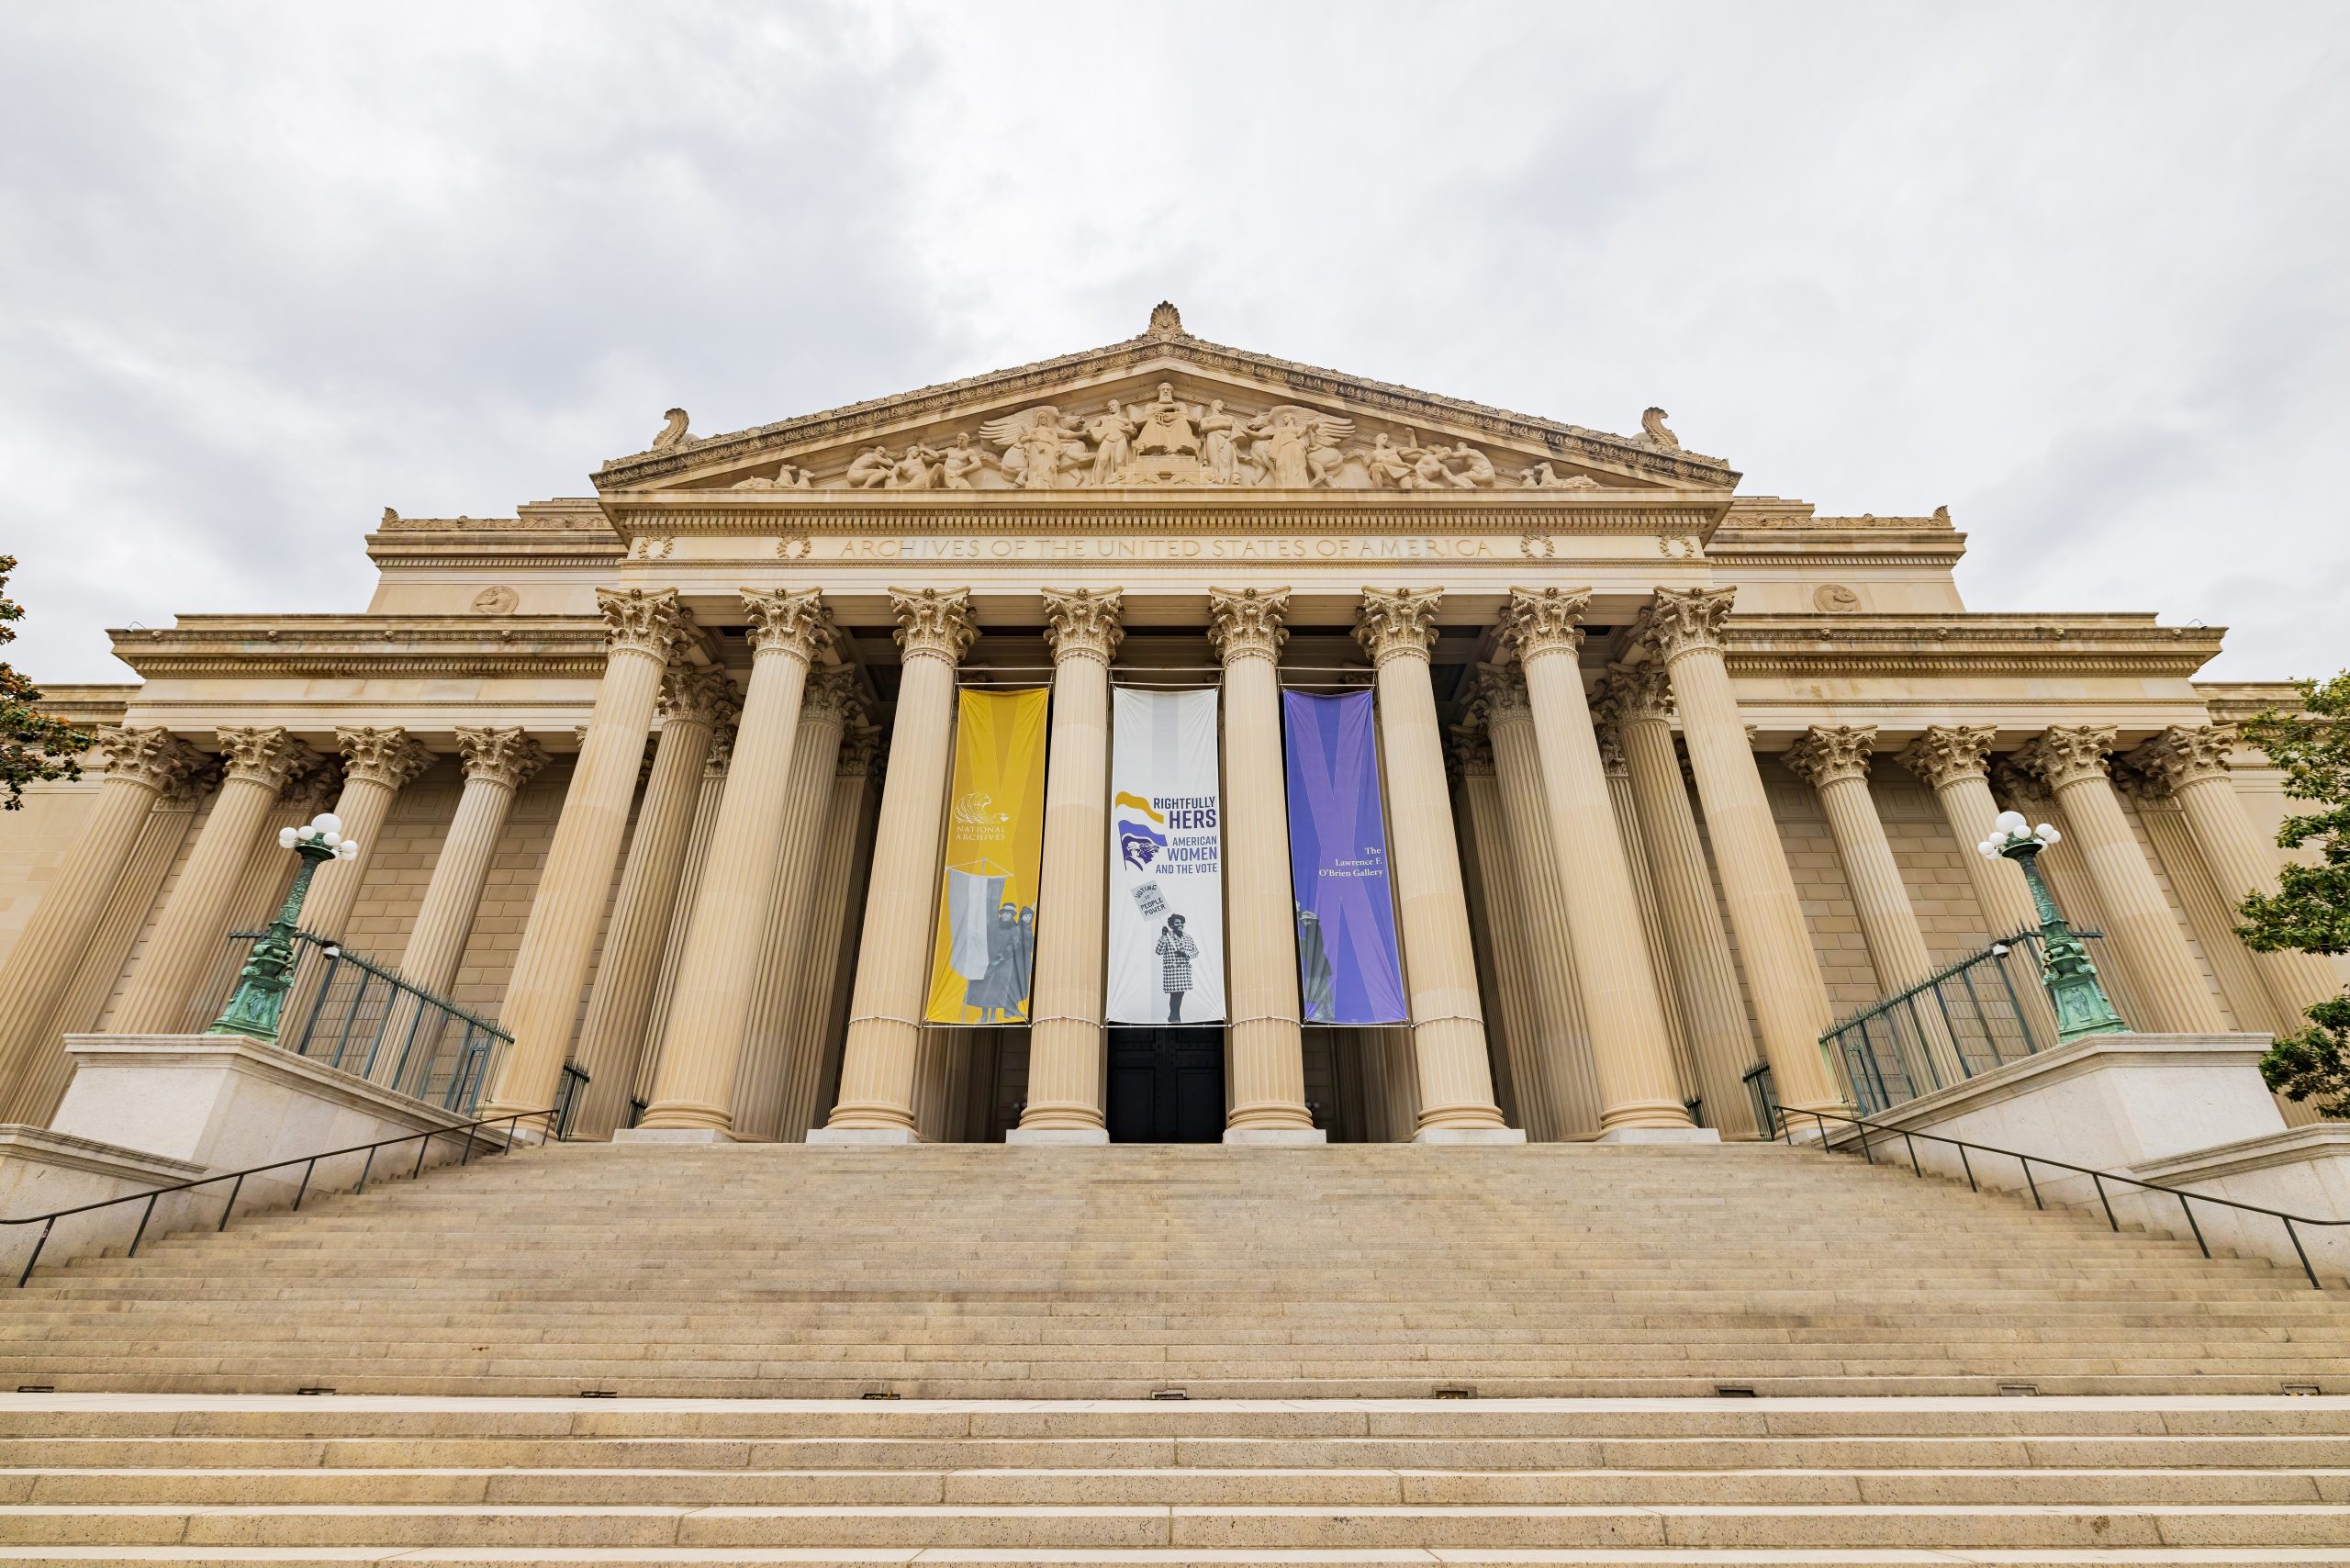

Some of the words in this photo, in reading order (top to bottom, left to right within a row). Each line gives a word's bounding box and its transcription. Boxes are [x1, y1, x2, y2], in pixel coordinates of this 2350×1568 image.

[839, 540, 980, 557] ARCHIVES
[990, 540, 1025, 557] OF
[1035, 540, 1086, 557] THE
[1097, 540, 1201, 557] UNITED
[1212, 540, 1306, 557] STATES
[1315, 540, 1350, 557] OF
[1358, 540, 1494, 557] AMERICA
[1153, 796, 1215, 810] RIGHTFULLY
[1169, 809, 1216, 829] HERS
[957, 825, 1005, 834] NATIONAL
[956, 833, 1005, 841] ARCHIVES
[1172, 835, 1217, 846] AMERICAN
[1167, 846, 1217, 861] WOMEN
[1364, 846, 1382, 855] The
[1156, 864, 1174, 874] AND
[1176, 864, 1193, 874] THE
[1195, 863, 1217, 873] VOTE
[1335, 858, 1374, 867] Lawrence
[1352, 868, 1383, 878] Gallery
[1135, 884, 1158, 899] VOTING
[1140, 897, 1164, 911] PEOPLE
[1144, 903, 1166, 916] POWER
